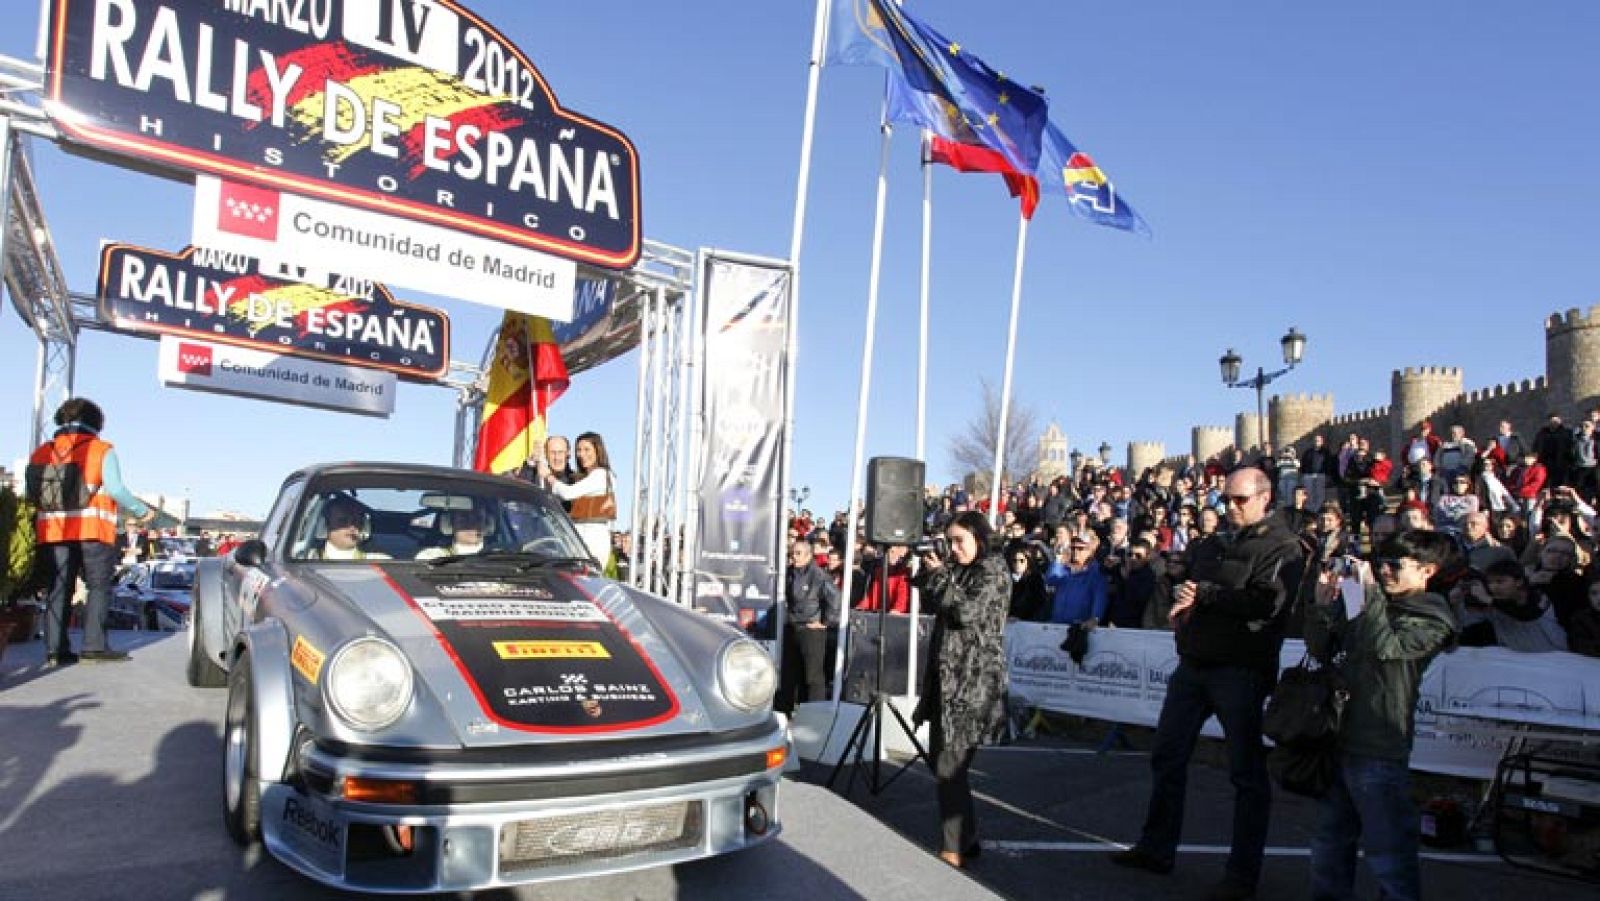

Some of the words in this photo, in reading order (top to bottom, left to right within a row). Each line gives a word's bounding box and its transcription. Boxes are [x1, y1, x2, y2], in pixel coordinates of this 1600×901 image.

[90, 0, 303, 128] RALLY
[323, 79, 400, 158] DE
[375, 0, 431, 54] IV
[464, 26, 535, 110] 2012
[140, 115, 586, 241] HISTORICO
[293, 211, 441, 263] Comunidad
[448, 247, 476, 270] de
[483, 255, 556, 289] Madrid
[119, 253, 236, 317] RALLY
[247, 293, 292, 328] DE
[220, 358, 309, 385] Comunidad
[312, 375, 330, 388] de
[335, 376, 384, 395] Madrid
[505, 642, 599, 655] PIRELLI
[503, 684, 588, 698] CARLOS
[593, 683, 651, 693] SAINZ
[508, 694, 570, 706] KARTING
[590, 692, 657, 702] BUSINESS
[283, 797, 340, 848] Reebok
